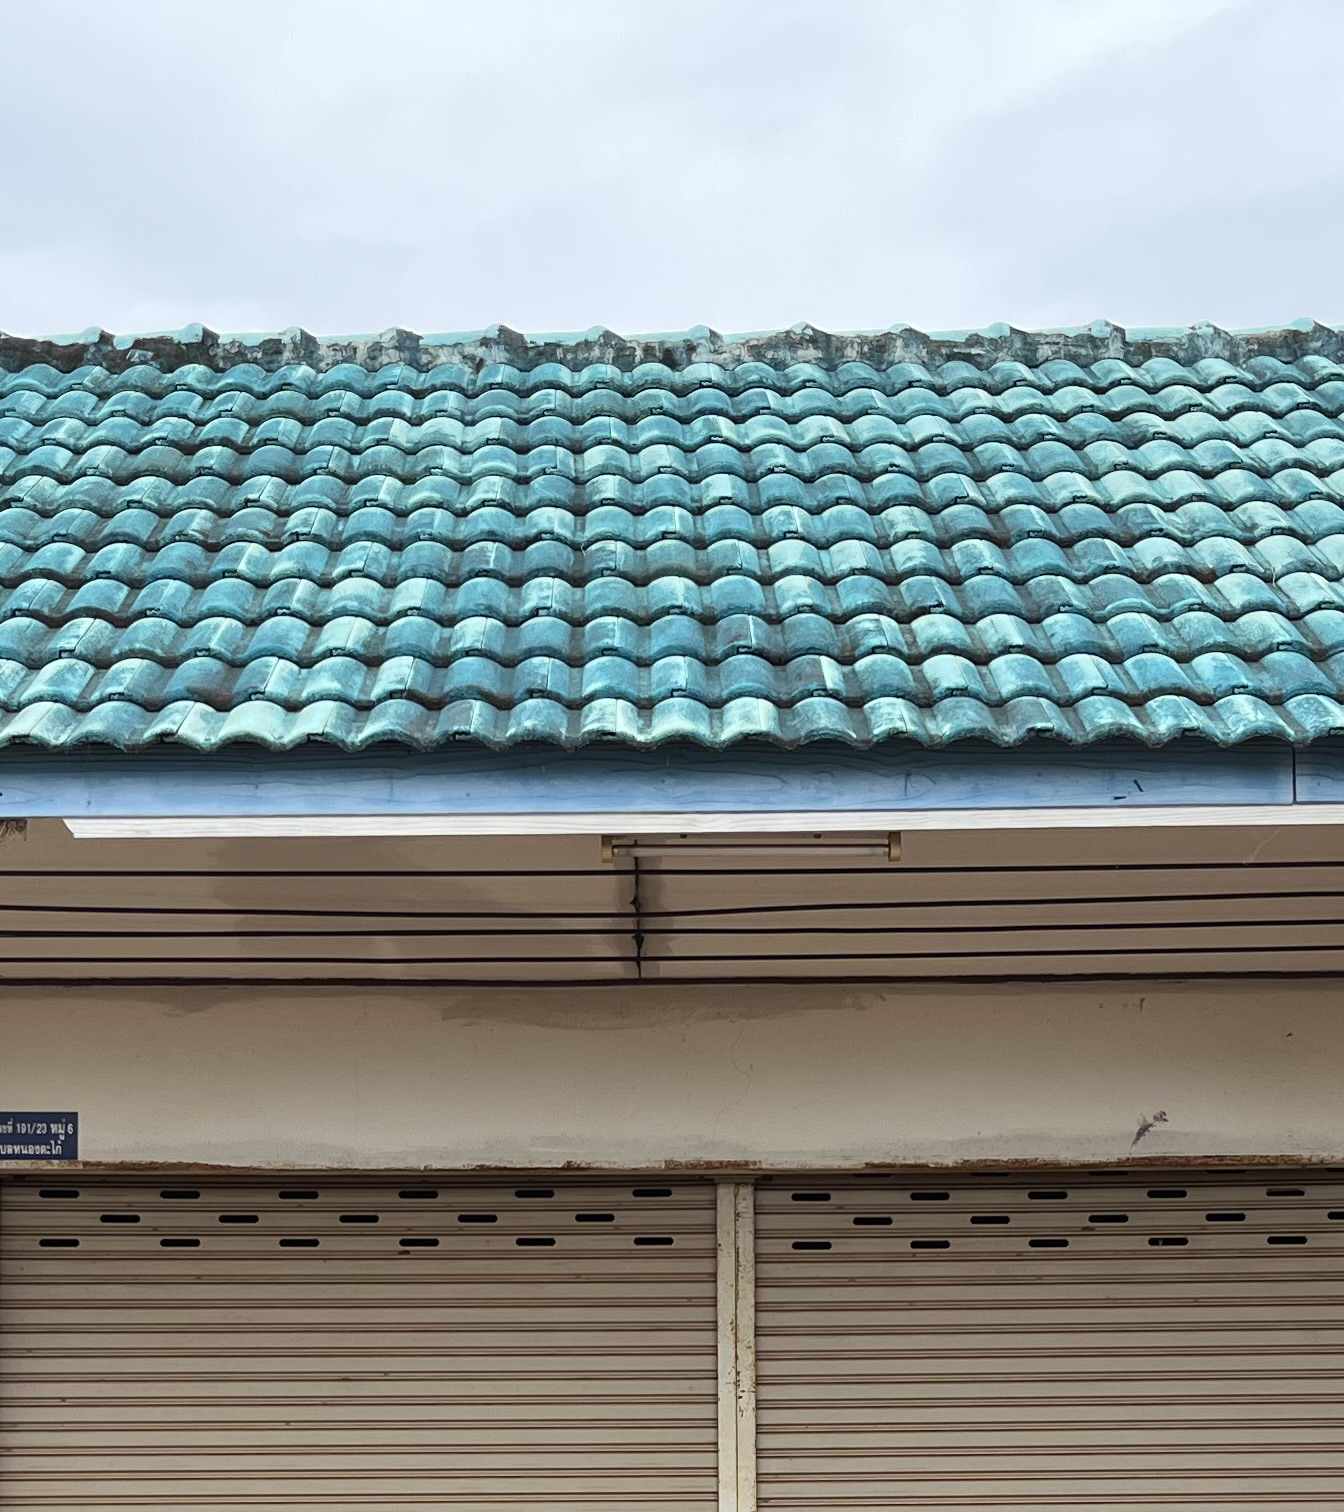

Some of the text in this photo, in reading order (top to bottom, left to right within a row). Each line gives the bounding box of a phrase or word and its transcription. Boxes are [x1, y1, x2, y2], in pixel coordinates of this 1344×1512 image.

[16, 1122, 47, 1135] 191/23
[50, 1119, 66, 1140] หมู่
[67, 1123, 74, 1135] 6
